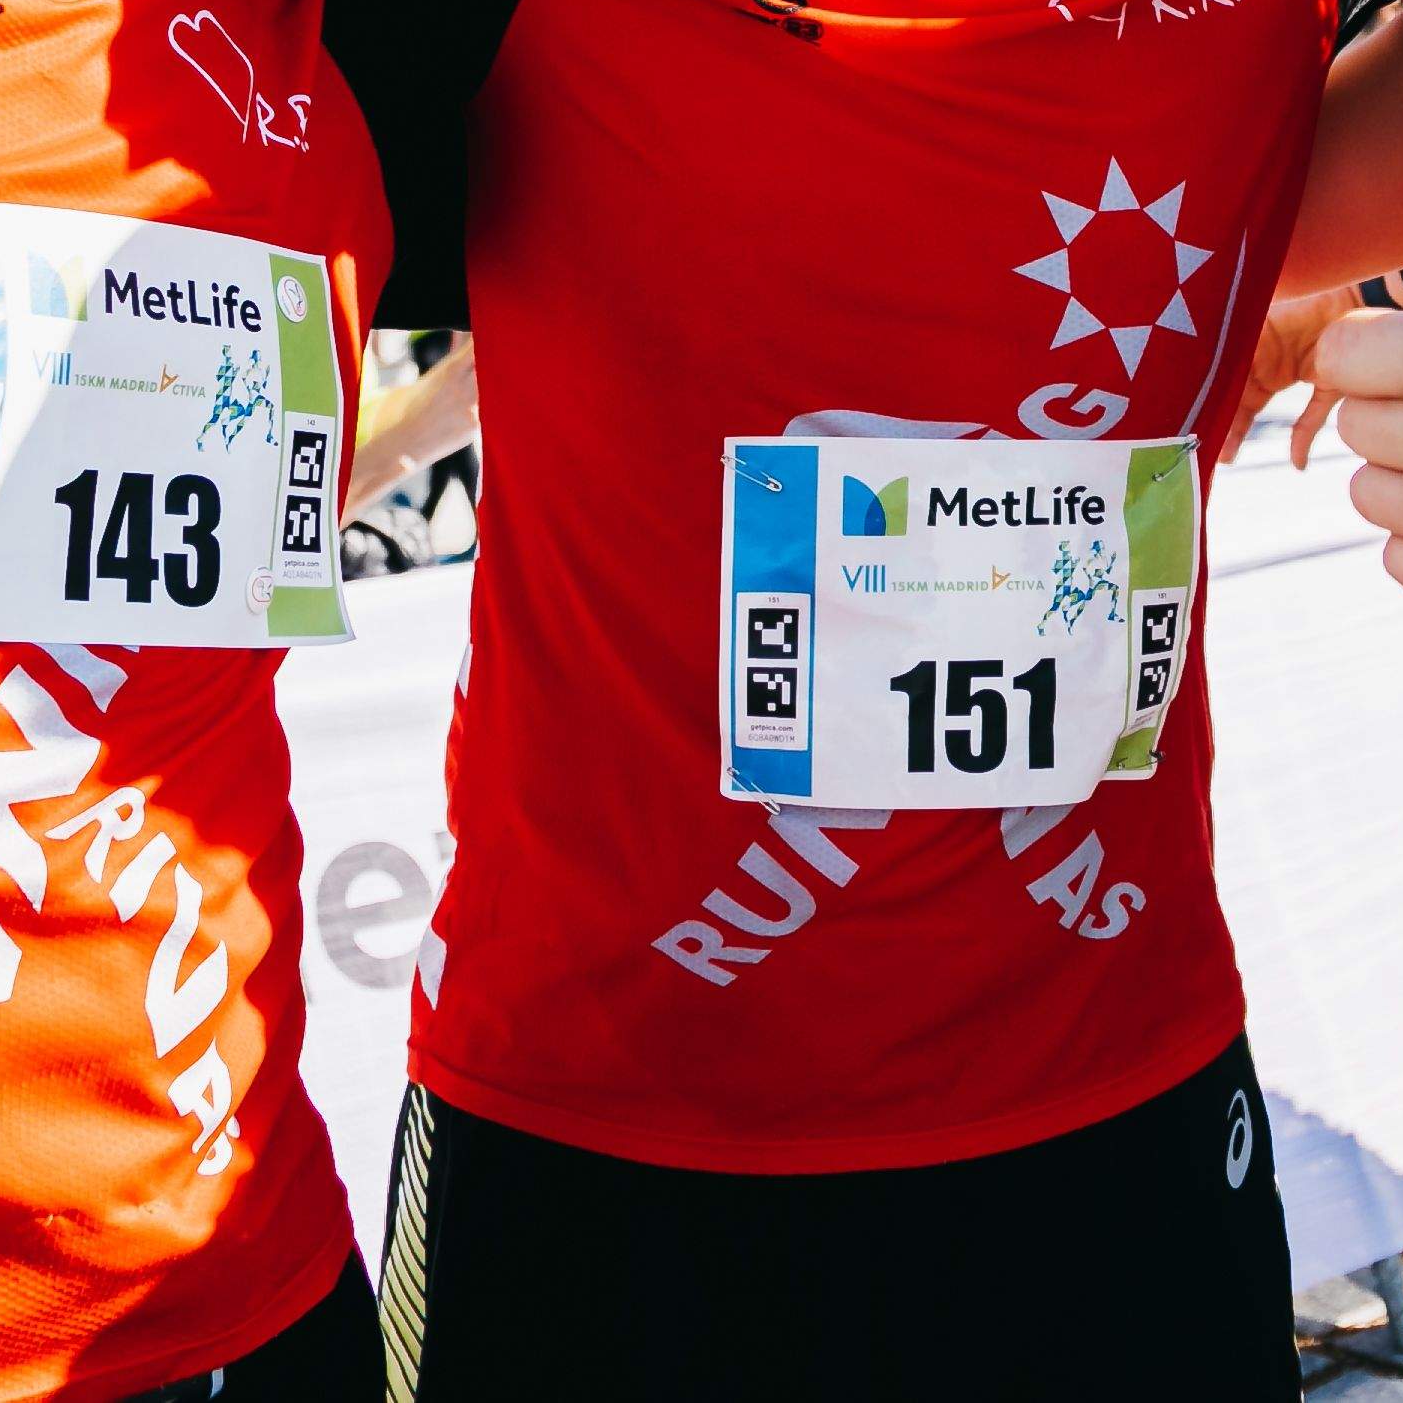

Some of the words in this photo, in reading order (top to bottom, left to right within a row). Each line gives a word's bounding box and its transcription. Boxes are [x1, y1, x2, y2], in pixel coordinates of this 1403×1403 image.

[103, 267, 263, 334] MetLife
[32, 350, 72, 386] VIII
[926, 484, 1107, 529] MetLife
[53, 468, 222, 609] 143
[841, 564, 886, 593] VIII
[891, 581, 929, 593] 15KM
[889, 656, 1058, 775] 151
